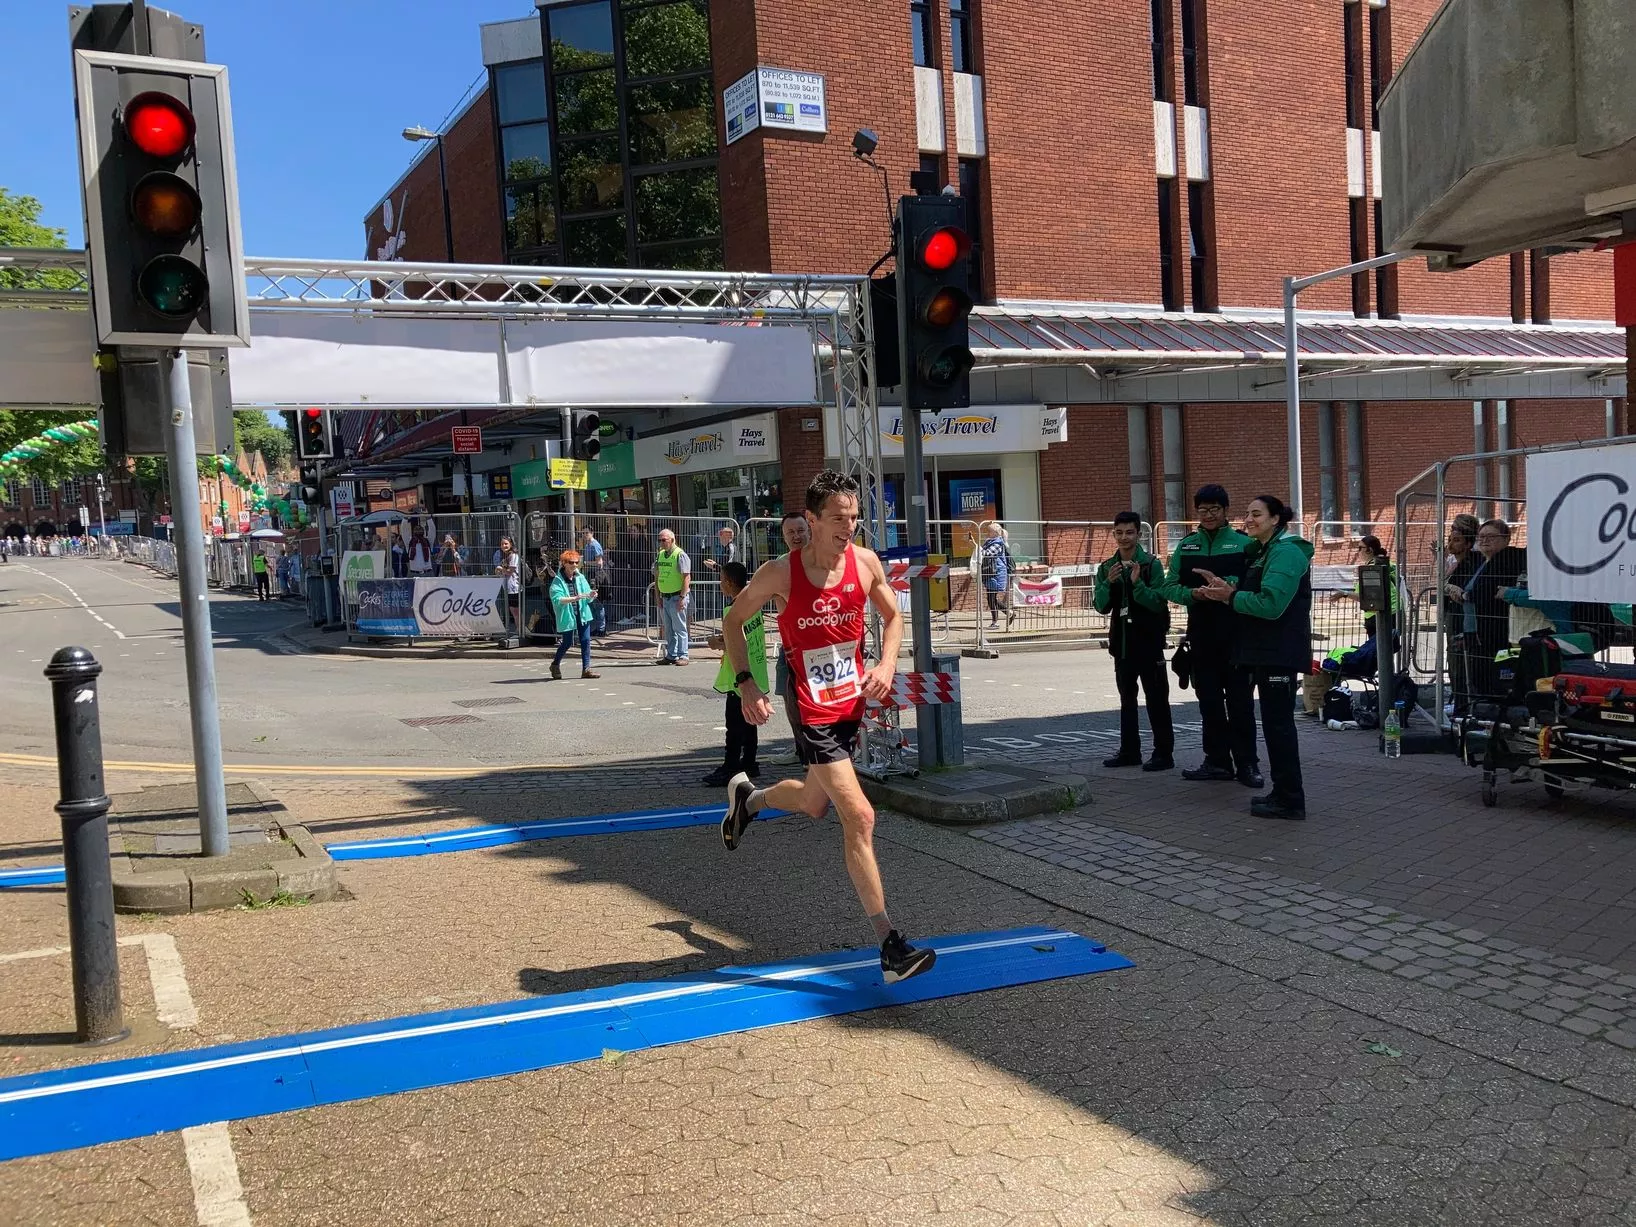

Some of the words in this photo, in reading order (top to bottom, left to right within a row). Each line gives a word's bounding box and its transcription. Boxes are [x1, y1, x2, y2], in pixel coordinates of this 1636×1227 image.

[762, 71, 793, 82] OFFICES
[808, 76, 820, 85] LET
[725, 83, 742, 98] OFFICES
[742, 80, 748, 88] TO
[892, 418, 938, 439] Hys
[942, 416, 998, 435] Travel
[1041, 426, 1060, 436] Travel
[1043, 418, 1058, 428] Hays
[739, 438, 766, 447] Travel
[741, 429, 762, 439] Hays
[668, 440, 690, 457] Hays
[690, 434, 718, 454] Travel
[961, 496, 985, 509] MORE
[1542, 473, 1636, 576] Co
[359, 591, 381, 609] Cookes
[419, 587, 493, 625] Cookes
[797, 612, 857, 630] goodgym
[810, 656, 855, 684] 3922
